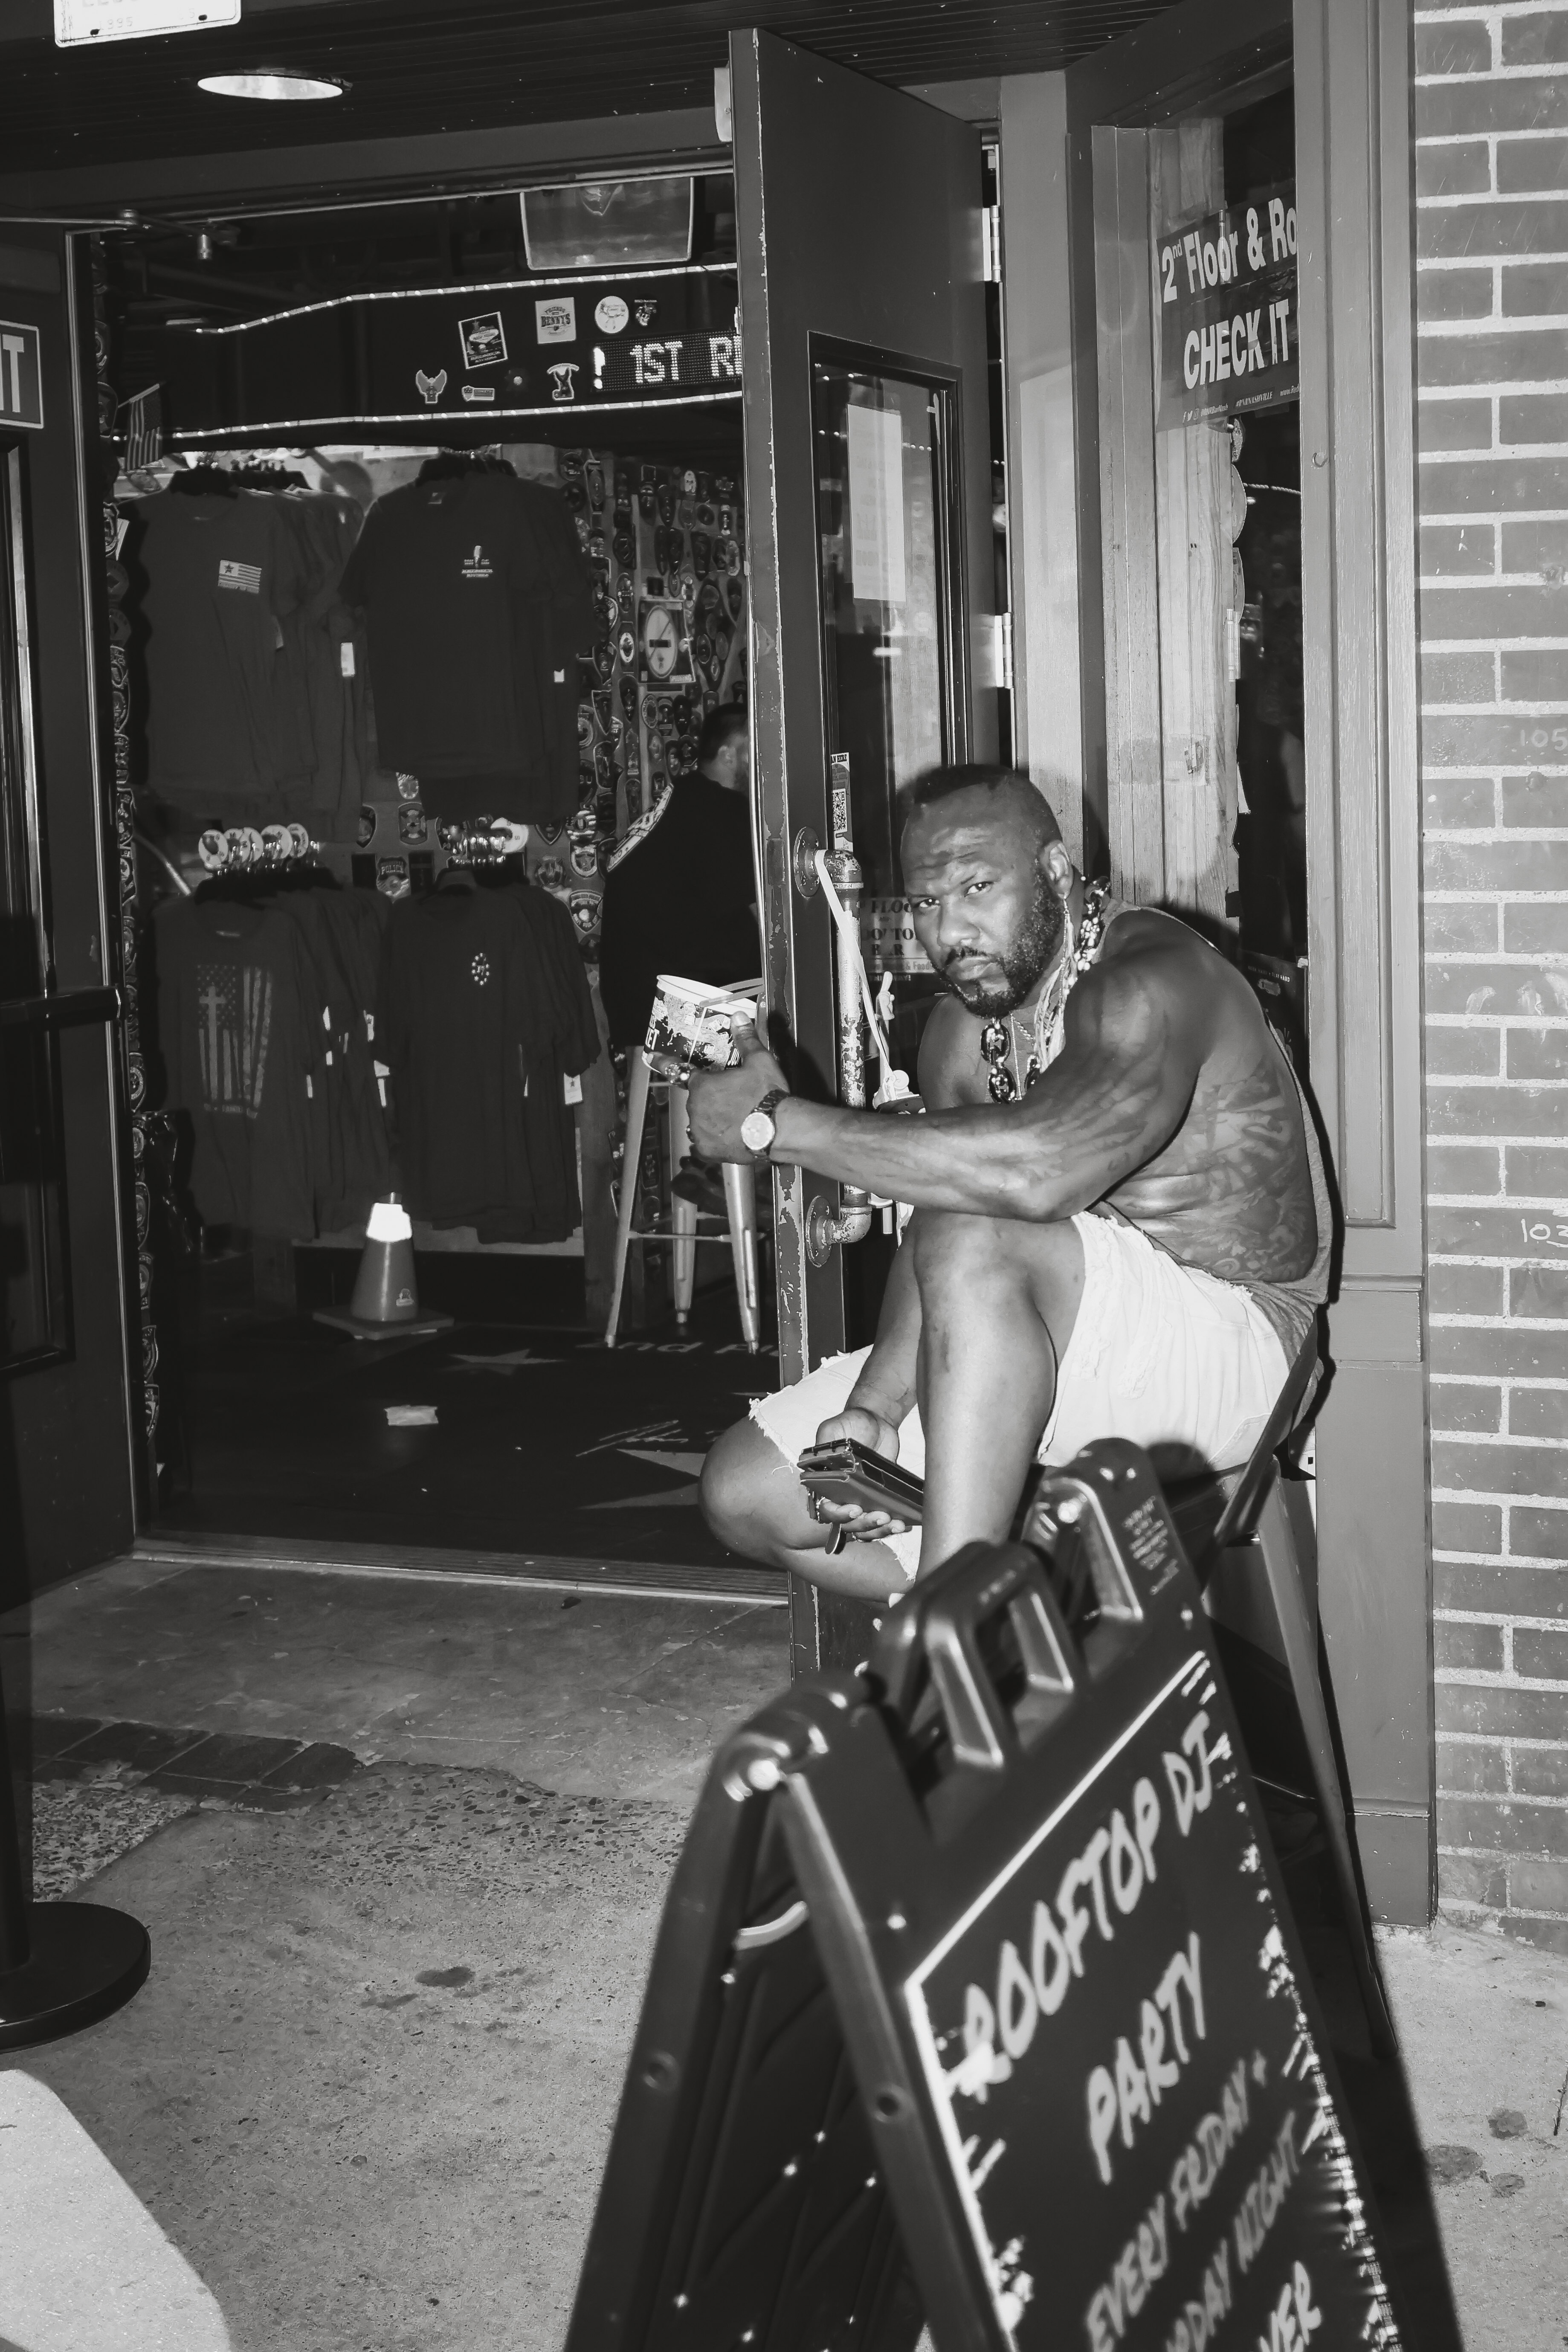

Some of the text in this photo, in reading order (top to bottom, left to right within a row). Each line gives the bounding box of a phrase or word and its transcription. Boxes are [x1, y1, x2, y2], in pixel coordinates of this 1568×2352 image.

[99, 16, 133, 30] 1995
[1184, 230, 1238, 293] Floor
[1246, 207, 1267, 271] &
[630, 341, 682, 383] 1ST
[1184, 299, 1290, 389] CHECK IT
[837, 754, 847, 763] HERE
[1520, 727, 1568, 751] 105
[963, 1709, 1213, 2089] ROOFTOP DJ
[1085, 1932, 1207, 2185] PARTY
[1085, 2192, 1169, 2352] EVERY
[1170, 2059, 1249, 2231] FRIDAY
[1234, 2110, 1300, 2273] NIGHT
